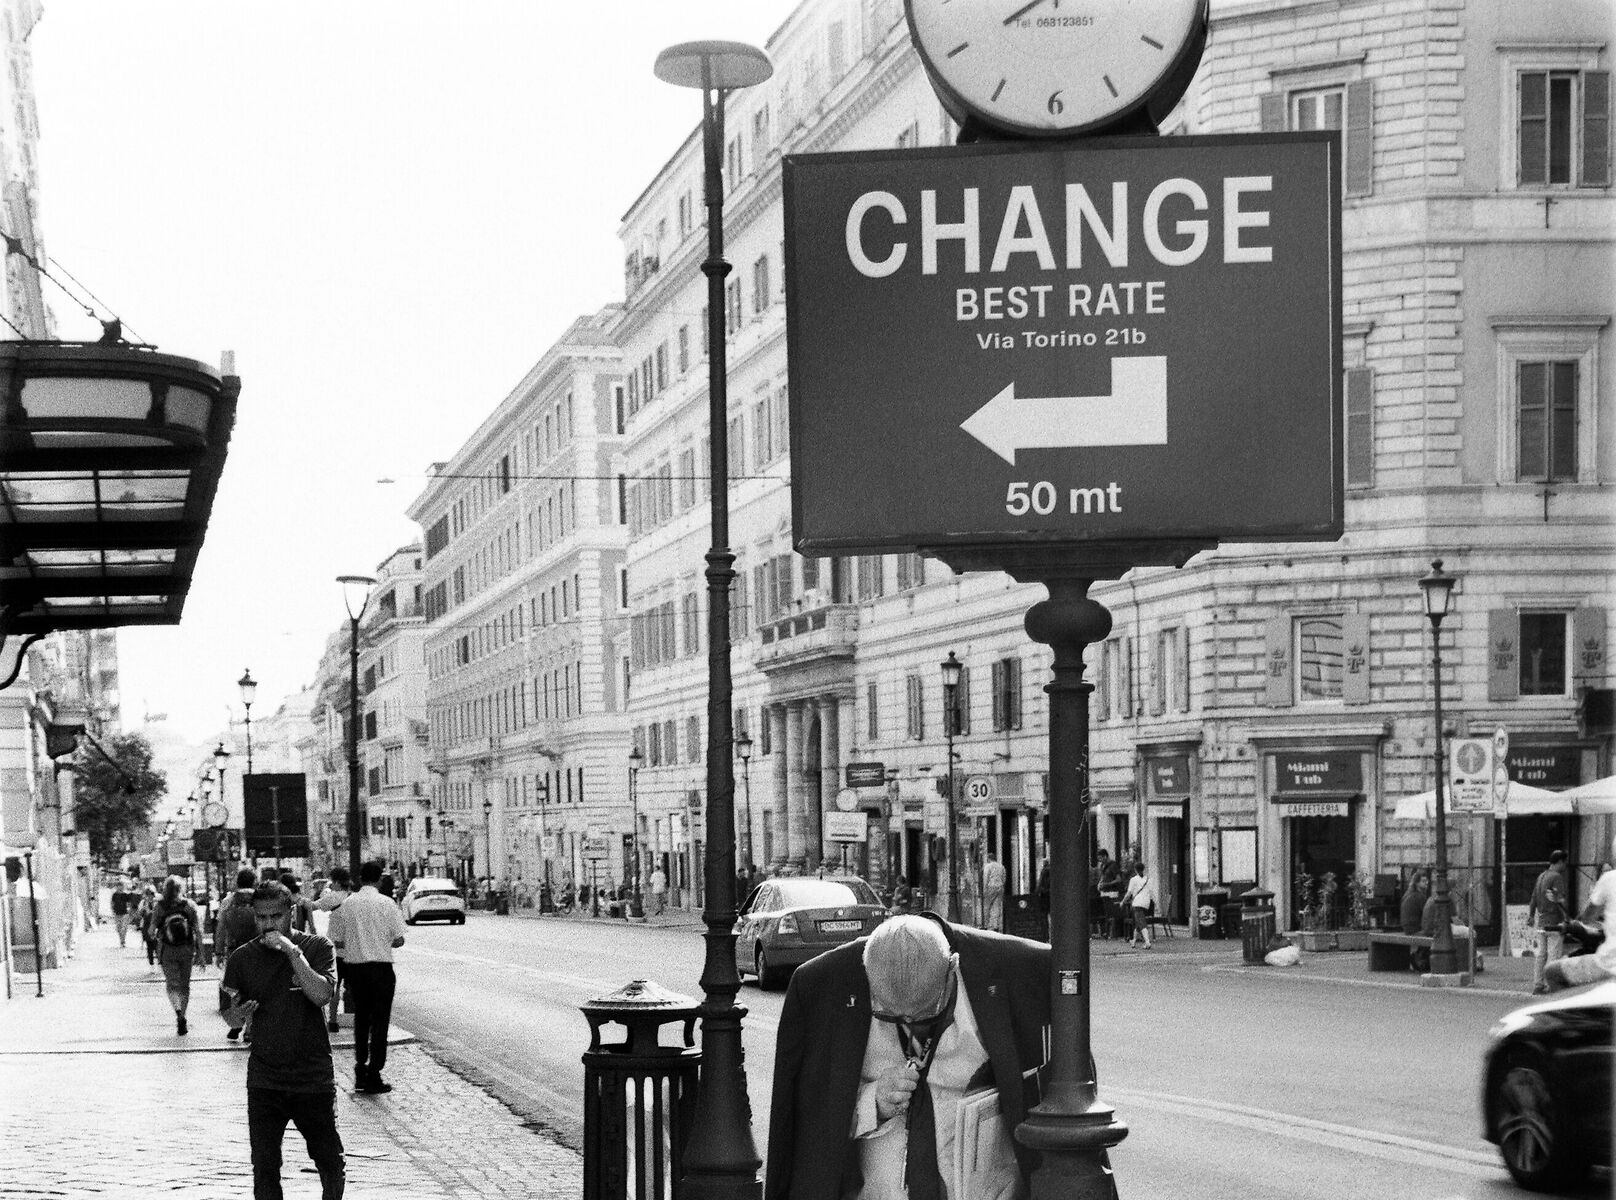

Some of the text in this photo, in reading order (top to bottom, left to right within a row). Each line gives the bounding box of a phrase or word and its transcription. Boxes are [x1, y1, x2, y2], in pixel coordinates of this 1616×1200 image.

[1047, 91, 1064, 115] 6
[845, 176, 1273, 278] CHANGE
[956, 281, 1166, 321] BEST RATE
[977, 328, 1147, 350] Via Torino 21b
[1005, 481, 1122, 516] 50 mt
[1287, 762, 1329, 772] Miami
[971, 783, 988, 798] 30
[1287, 804, 1339, 815] CAFFETTERIA
